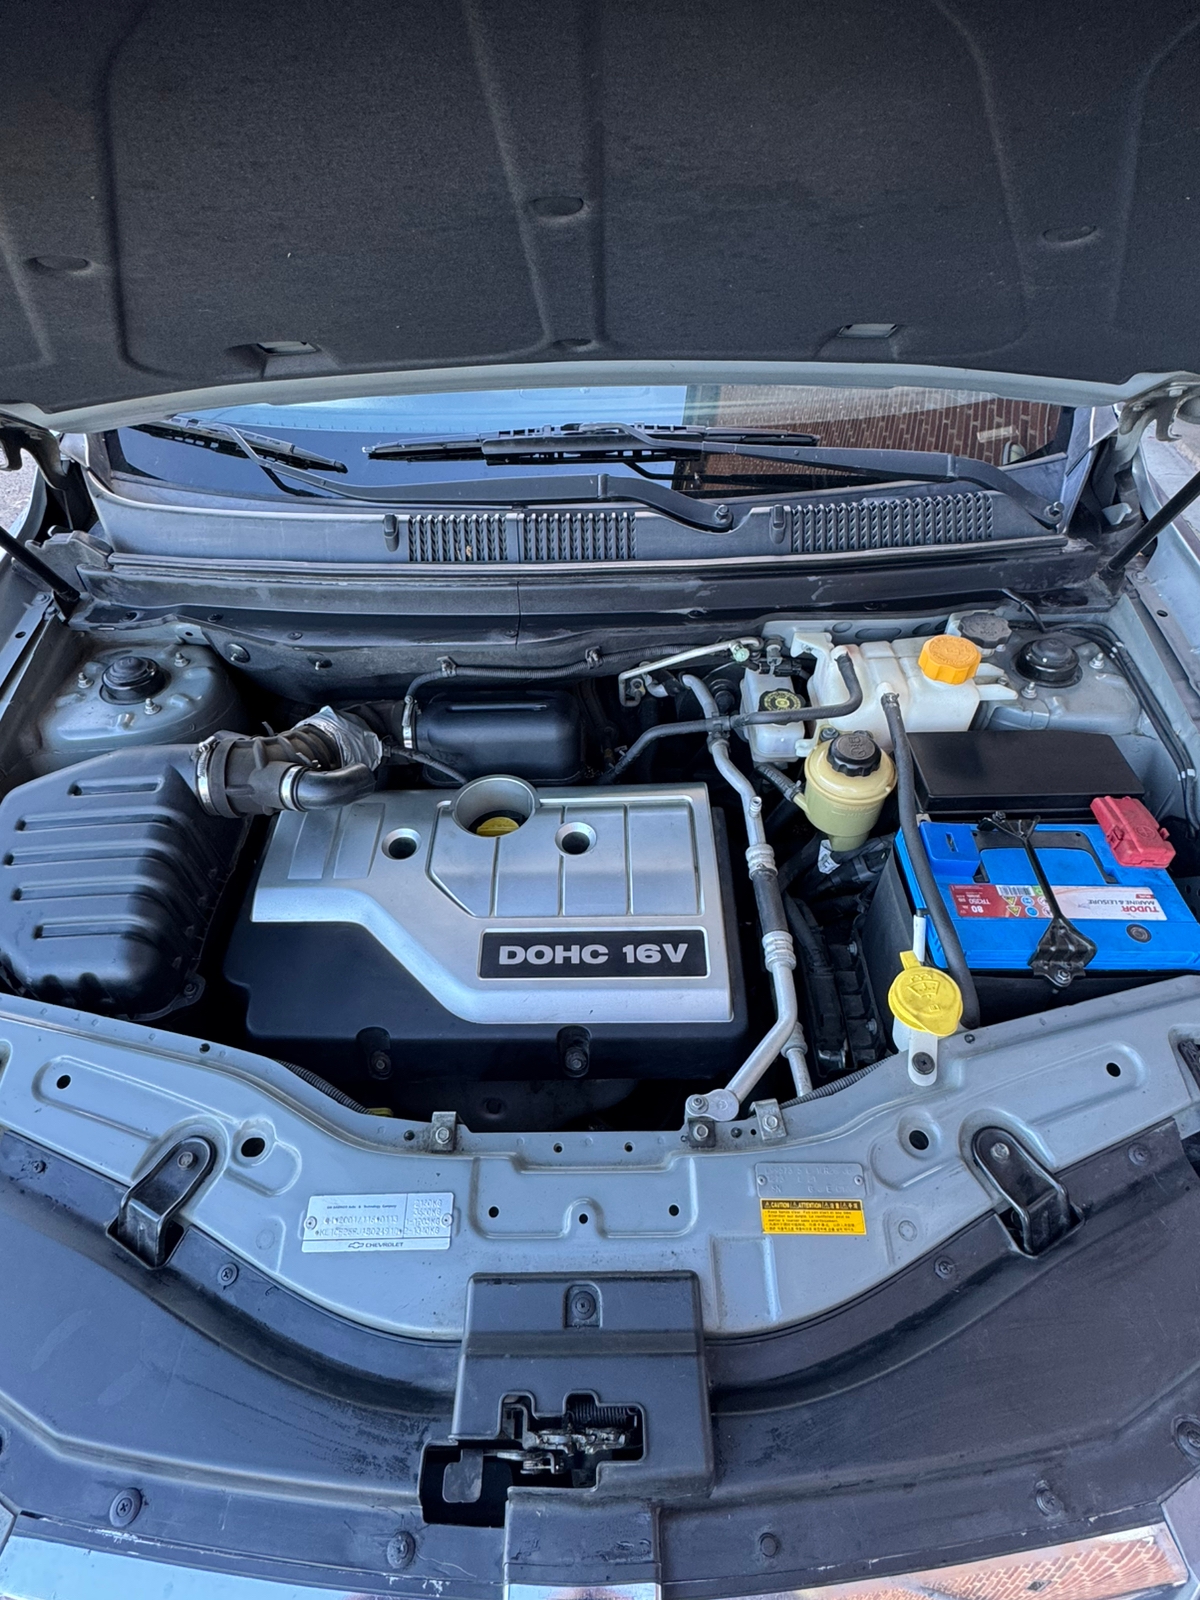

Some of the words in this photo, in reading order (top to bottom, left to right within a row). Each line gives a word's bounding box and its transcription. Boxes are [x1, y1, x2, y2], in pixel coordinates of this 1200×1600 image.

[1088, 898, 1118, 906] LEISURE
[970, 904, 984, 914] 80
[1121, 905, 1160, 913] TUDOR
[499, 944, 609, 965] DOHC
[622, 943, 689, 964] 16V
[365, 1241, 404, 1249] CHEVROLET
